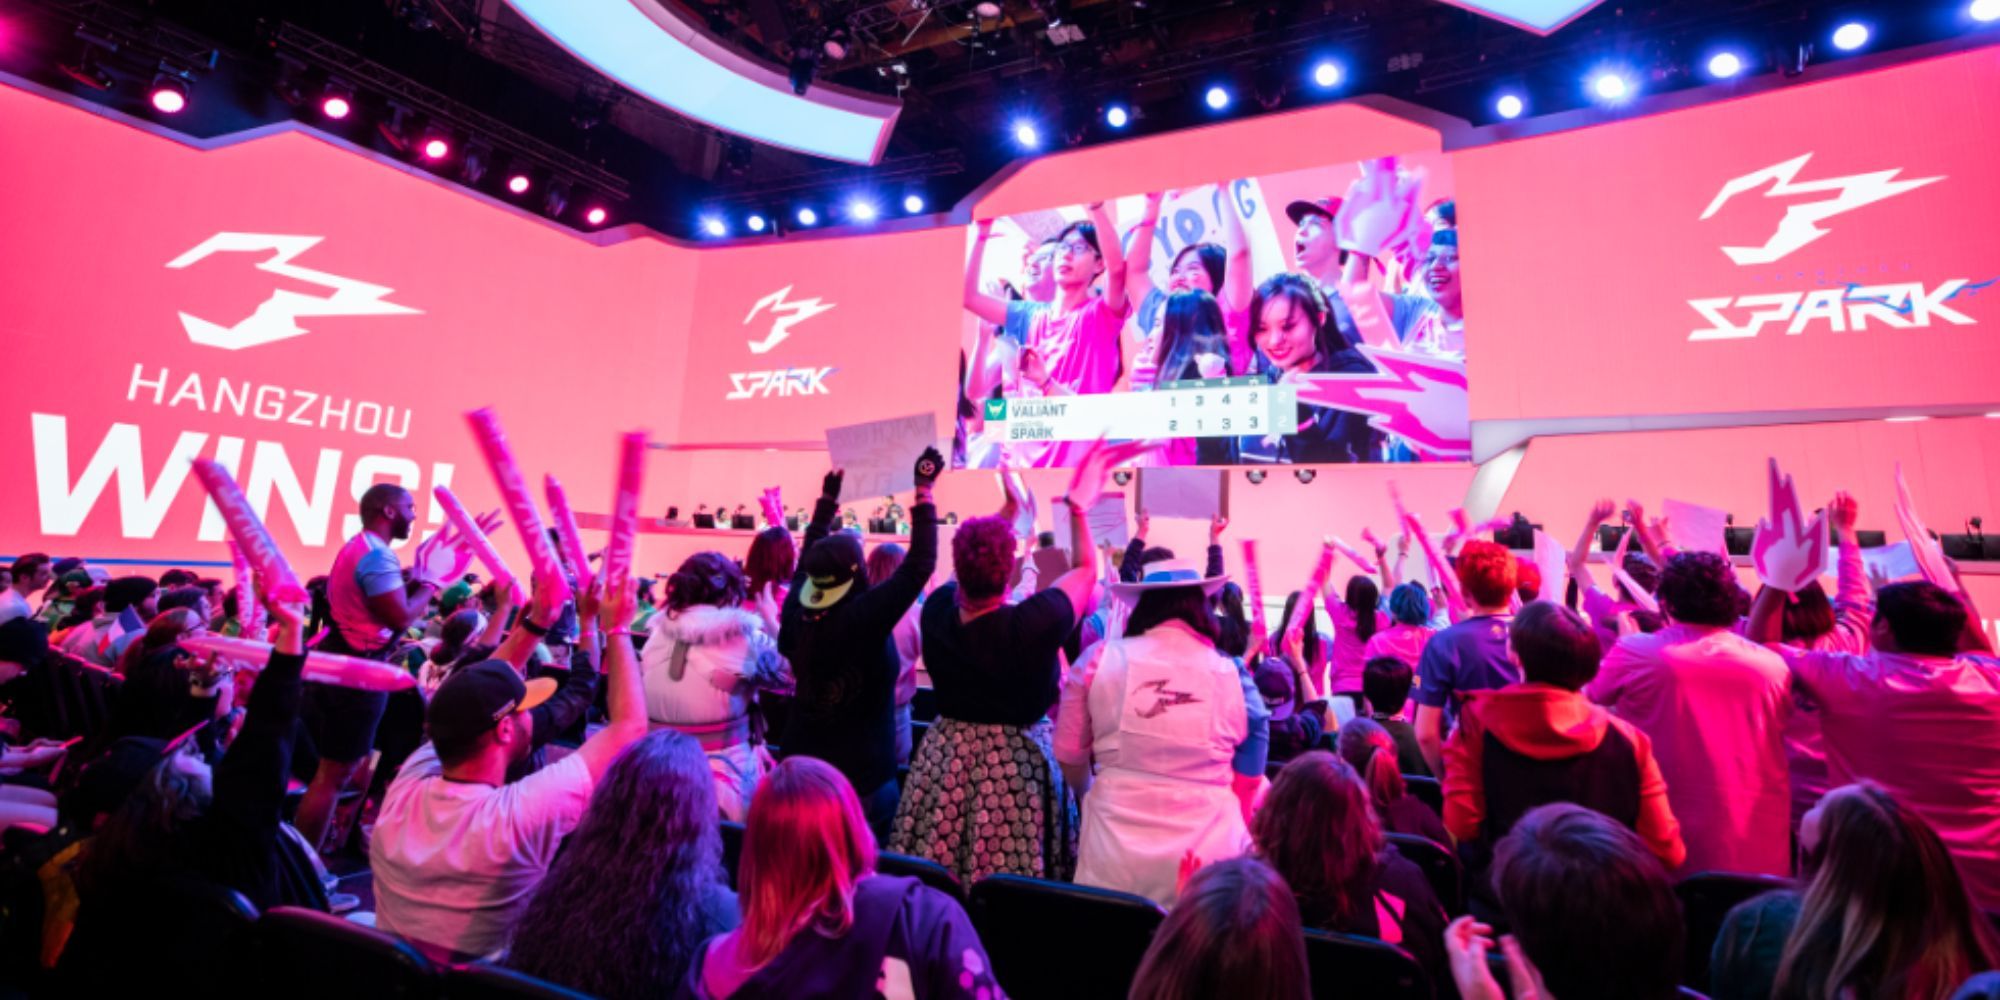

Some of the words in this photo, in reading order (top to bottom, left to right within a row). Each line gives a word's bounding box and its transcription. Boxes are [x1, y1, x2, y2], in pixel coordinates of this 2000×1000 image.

[1687, 279, 1978, 341] SPARK
[127, 363, 412, 440] HANGZHOU
[726, 366, 832, 400] SPARK
[1012, 403, 1067, 418] VALIANT
[1171, 396, 1177, 408] 1
[1196, 395, 1204, 407] 3
[1222, 393, 1231, 405] 4
[1249, 391, 1257, 404] 2
[1011, 426, 1054, 440] SPARK
[1169, 419, 1178, 431] 2
[1197, 419, 1203, 431] 1
[1222, 417, 1231, 430] 3
[1249, 416, 1258, 429] 3
[31, 412, 455, 550] WINS!
